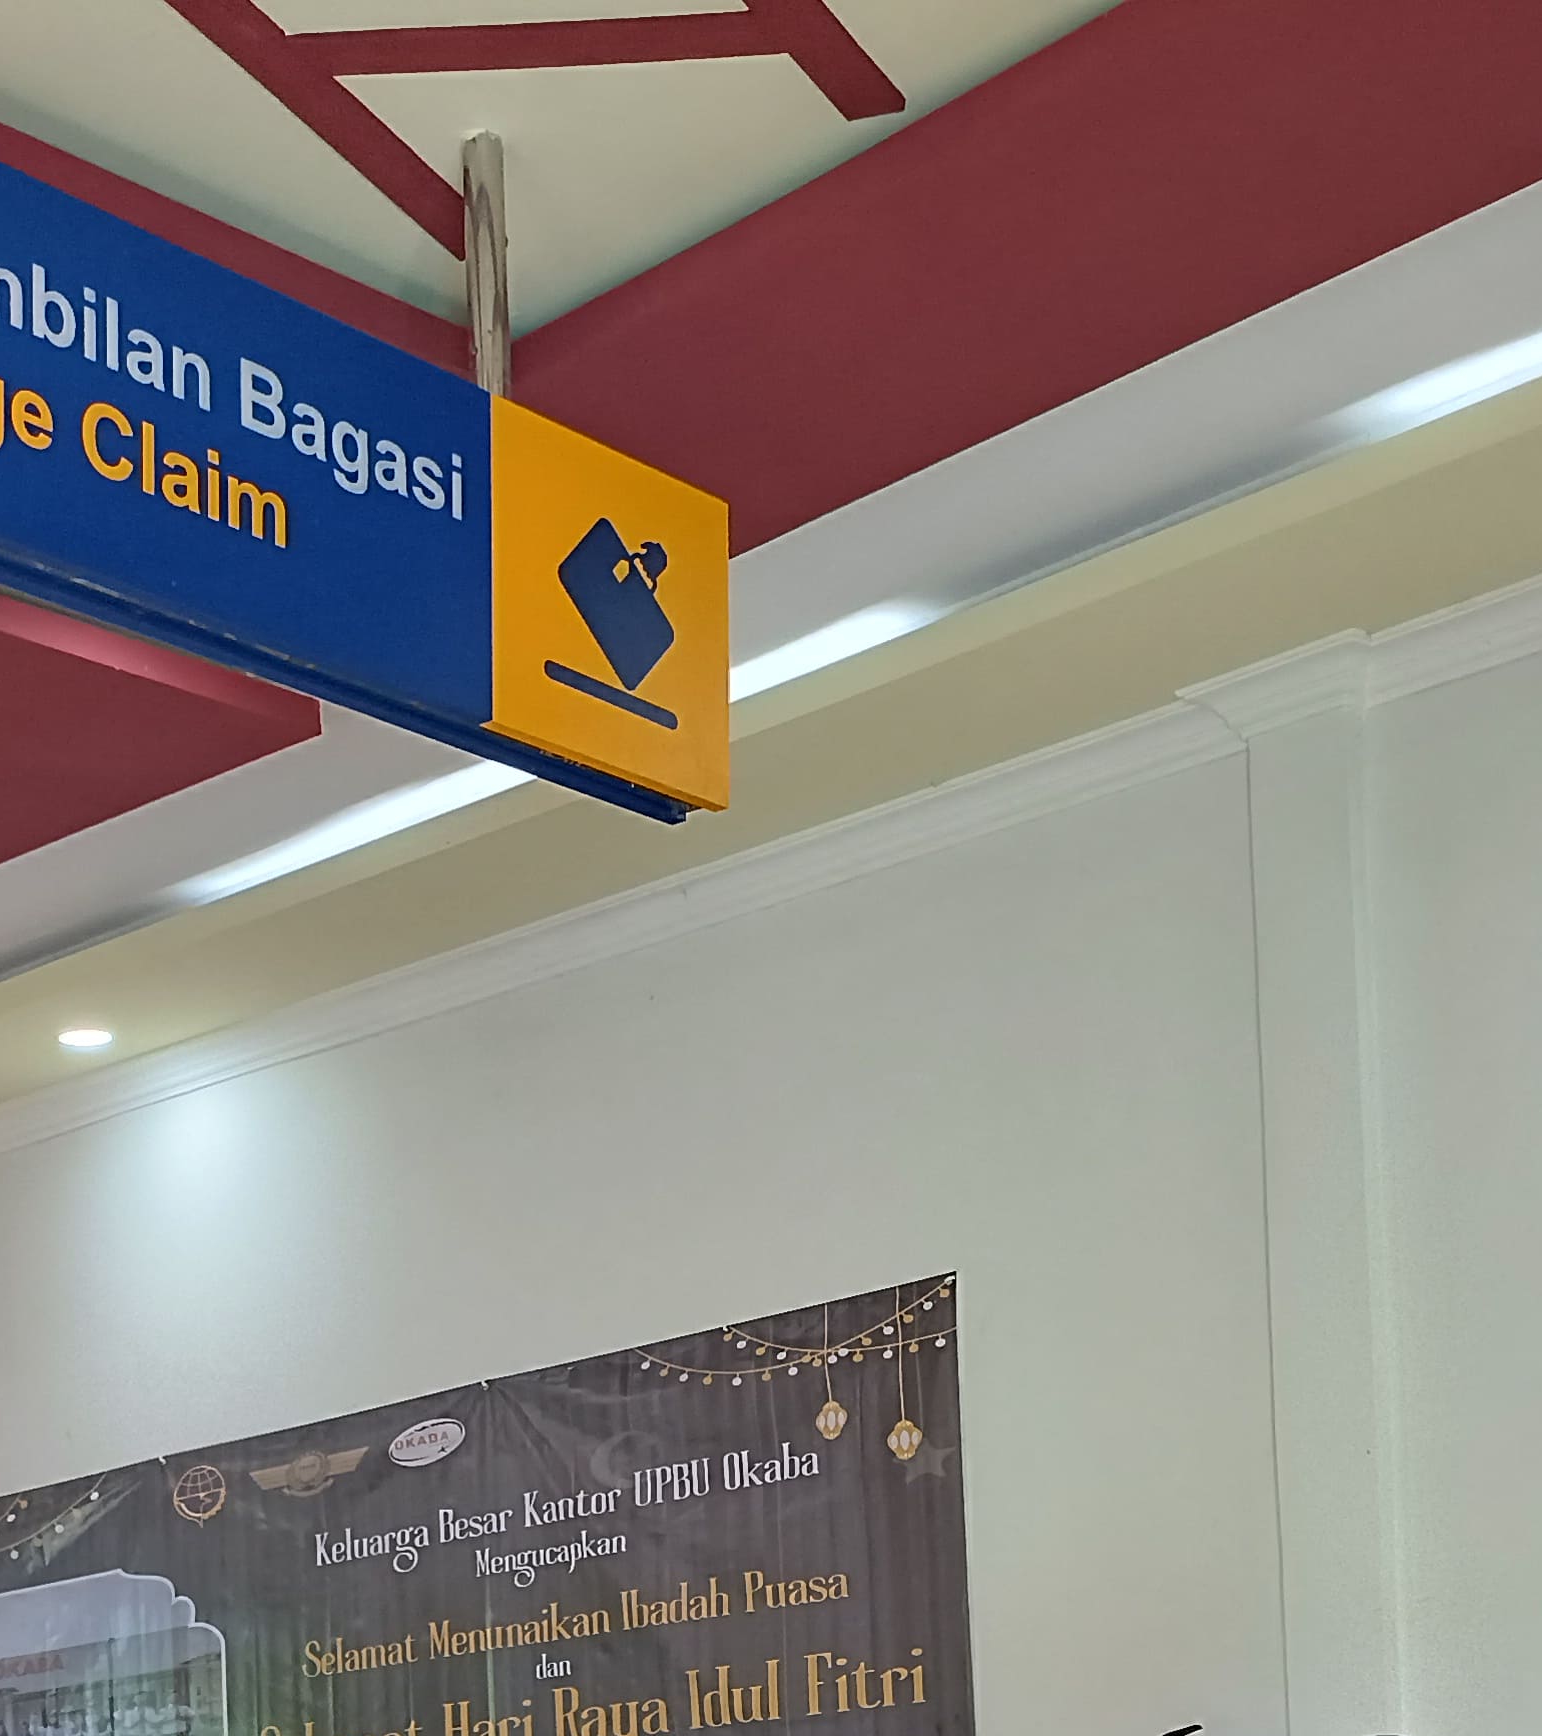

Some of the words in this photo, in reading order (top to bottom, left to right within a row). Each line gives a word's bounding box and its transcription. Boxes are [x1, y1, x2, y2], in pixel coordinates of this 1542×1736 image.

[80, 402, 289, 549] Claim
[238, 357, 464, 520] Bagasi
[313, 1520, 430, 1573] Keluarga
[437, 1508, 513, 1545] Besar
[522, 1483, 622, 1528] Kantor
[633, 1456, 711, 1508] UPBU
[722, 1442, 820, 1492] Okaba
[474, 1531, 628, 1588] Mengucapkan
[302, 1640, 417, 1679] Selamat
[428, 1601, 611, 1658] Menunaikan
[620, 1579, 730, 1633] Ibadah
[743, 1570, 849, 1614] Puasa
[535, 1655, 572, 1680] dan
[686, 1658, 782, 1732] Idul
[804, 1647, 927, 1717] Fitri
